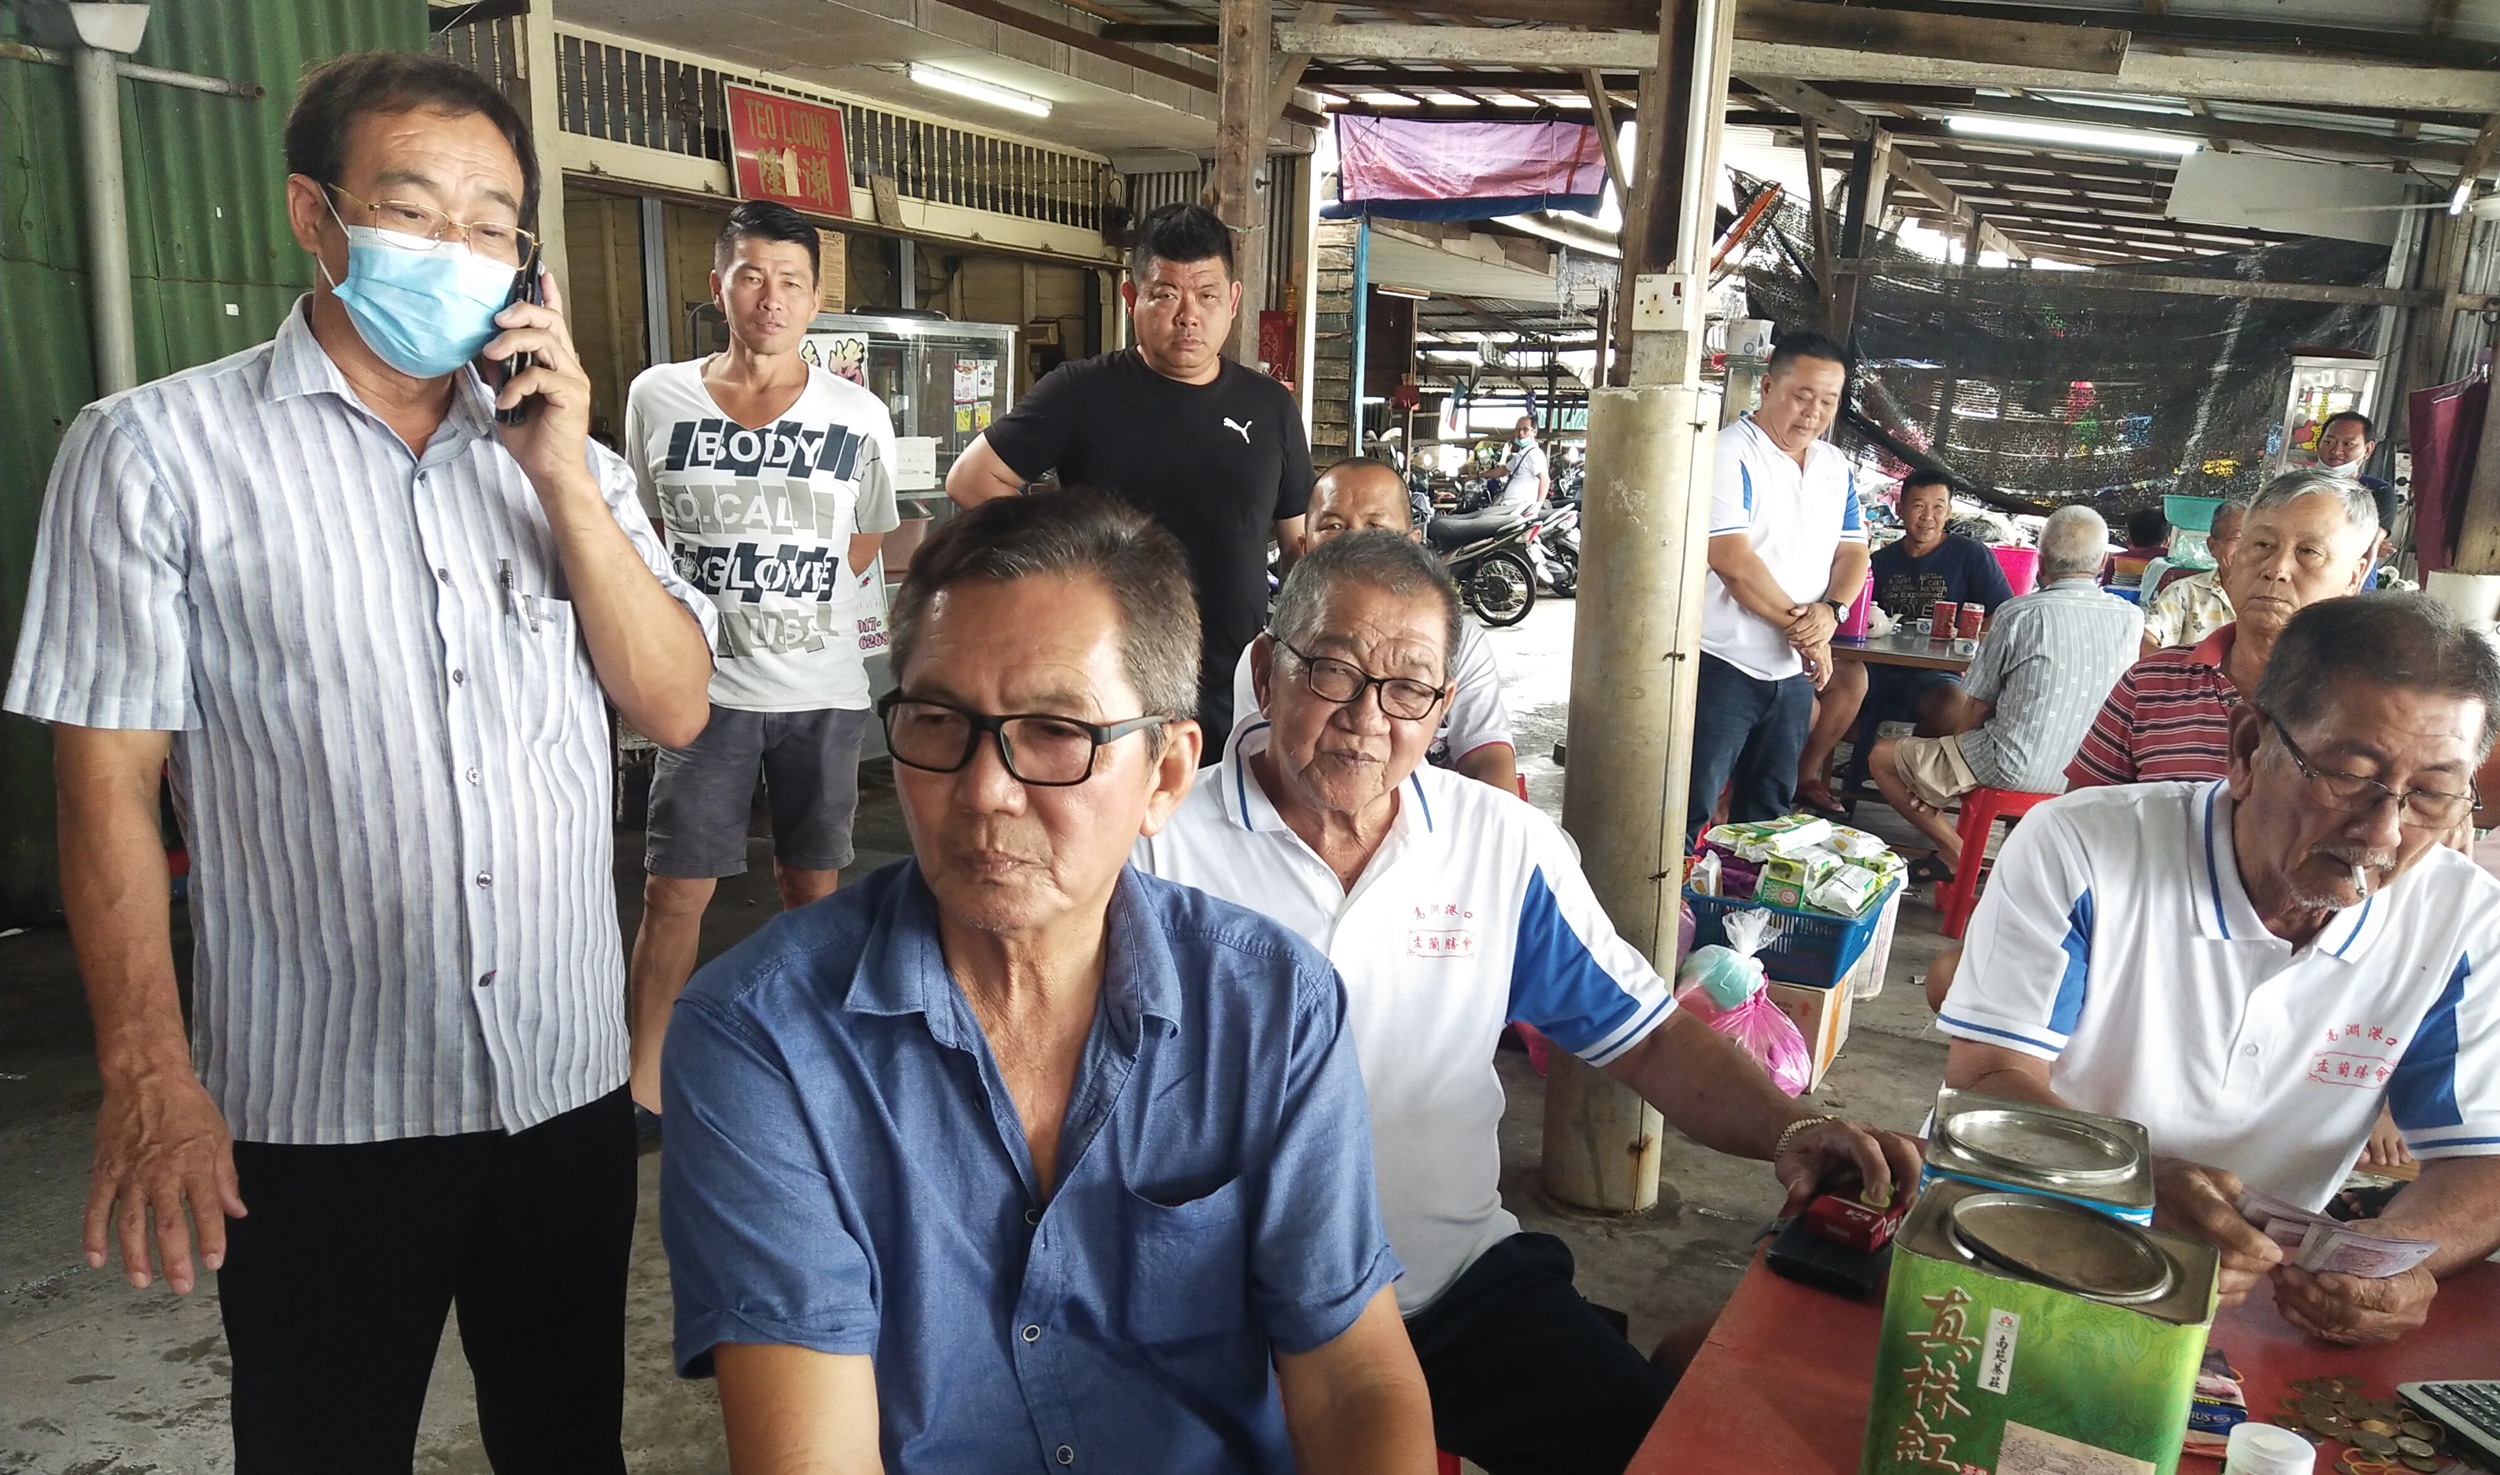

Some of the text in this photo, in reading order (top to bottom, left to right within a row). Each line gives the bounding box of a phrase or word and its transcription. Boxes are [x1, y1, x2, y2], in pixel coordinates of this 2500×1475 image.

[744, 98, 830, 151] TEO LOONG
[697, 431, 824, 467] BODY
[703, 556, 831, 591] GLOVE
